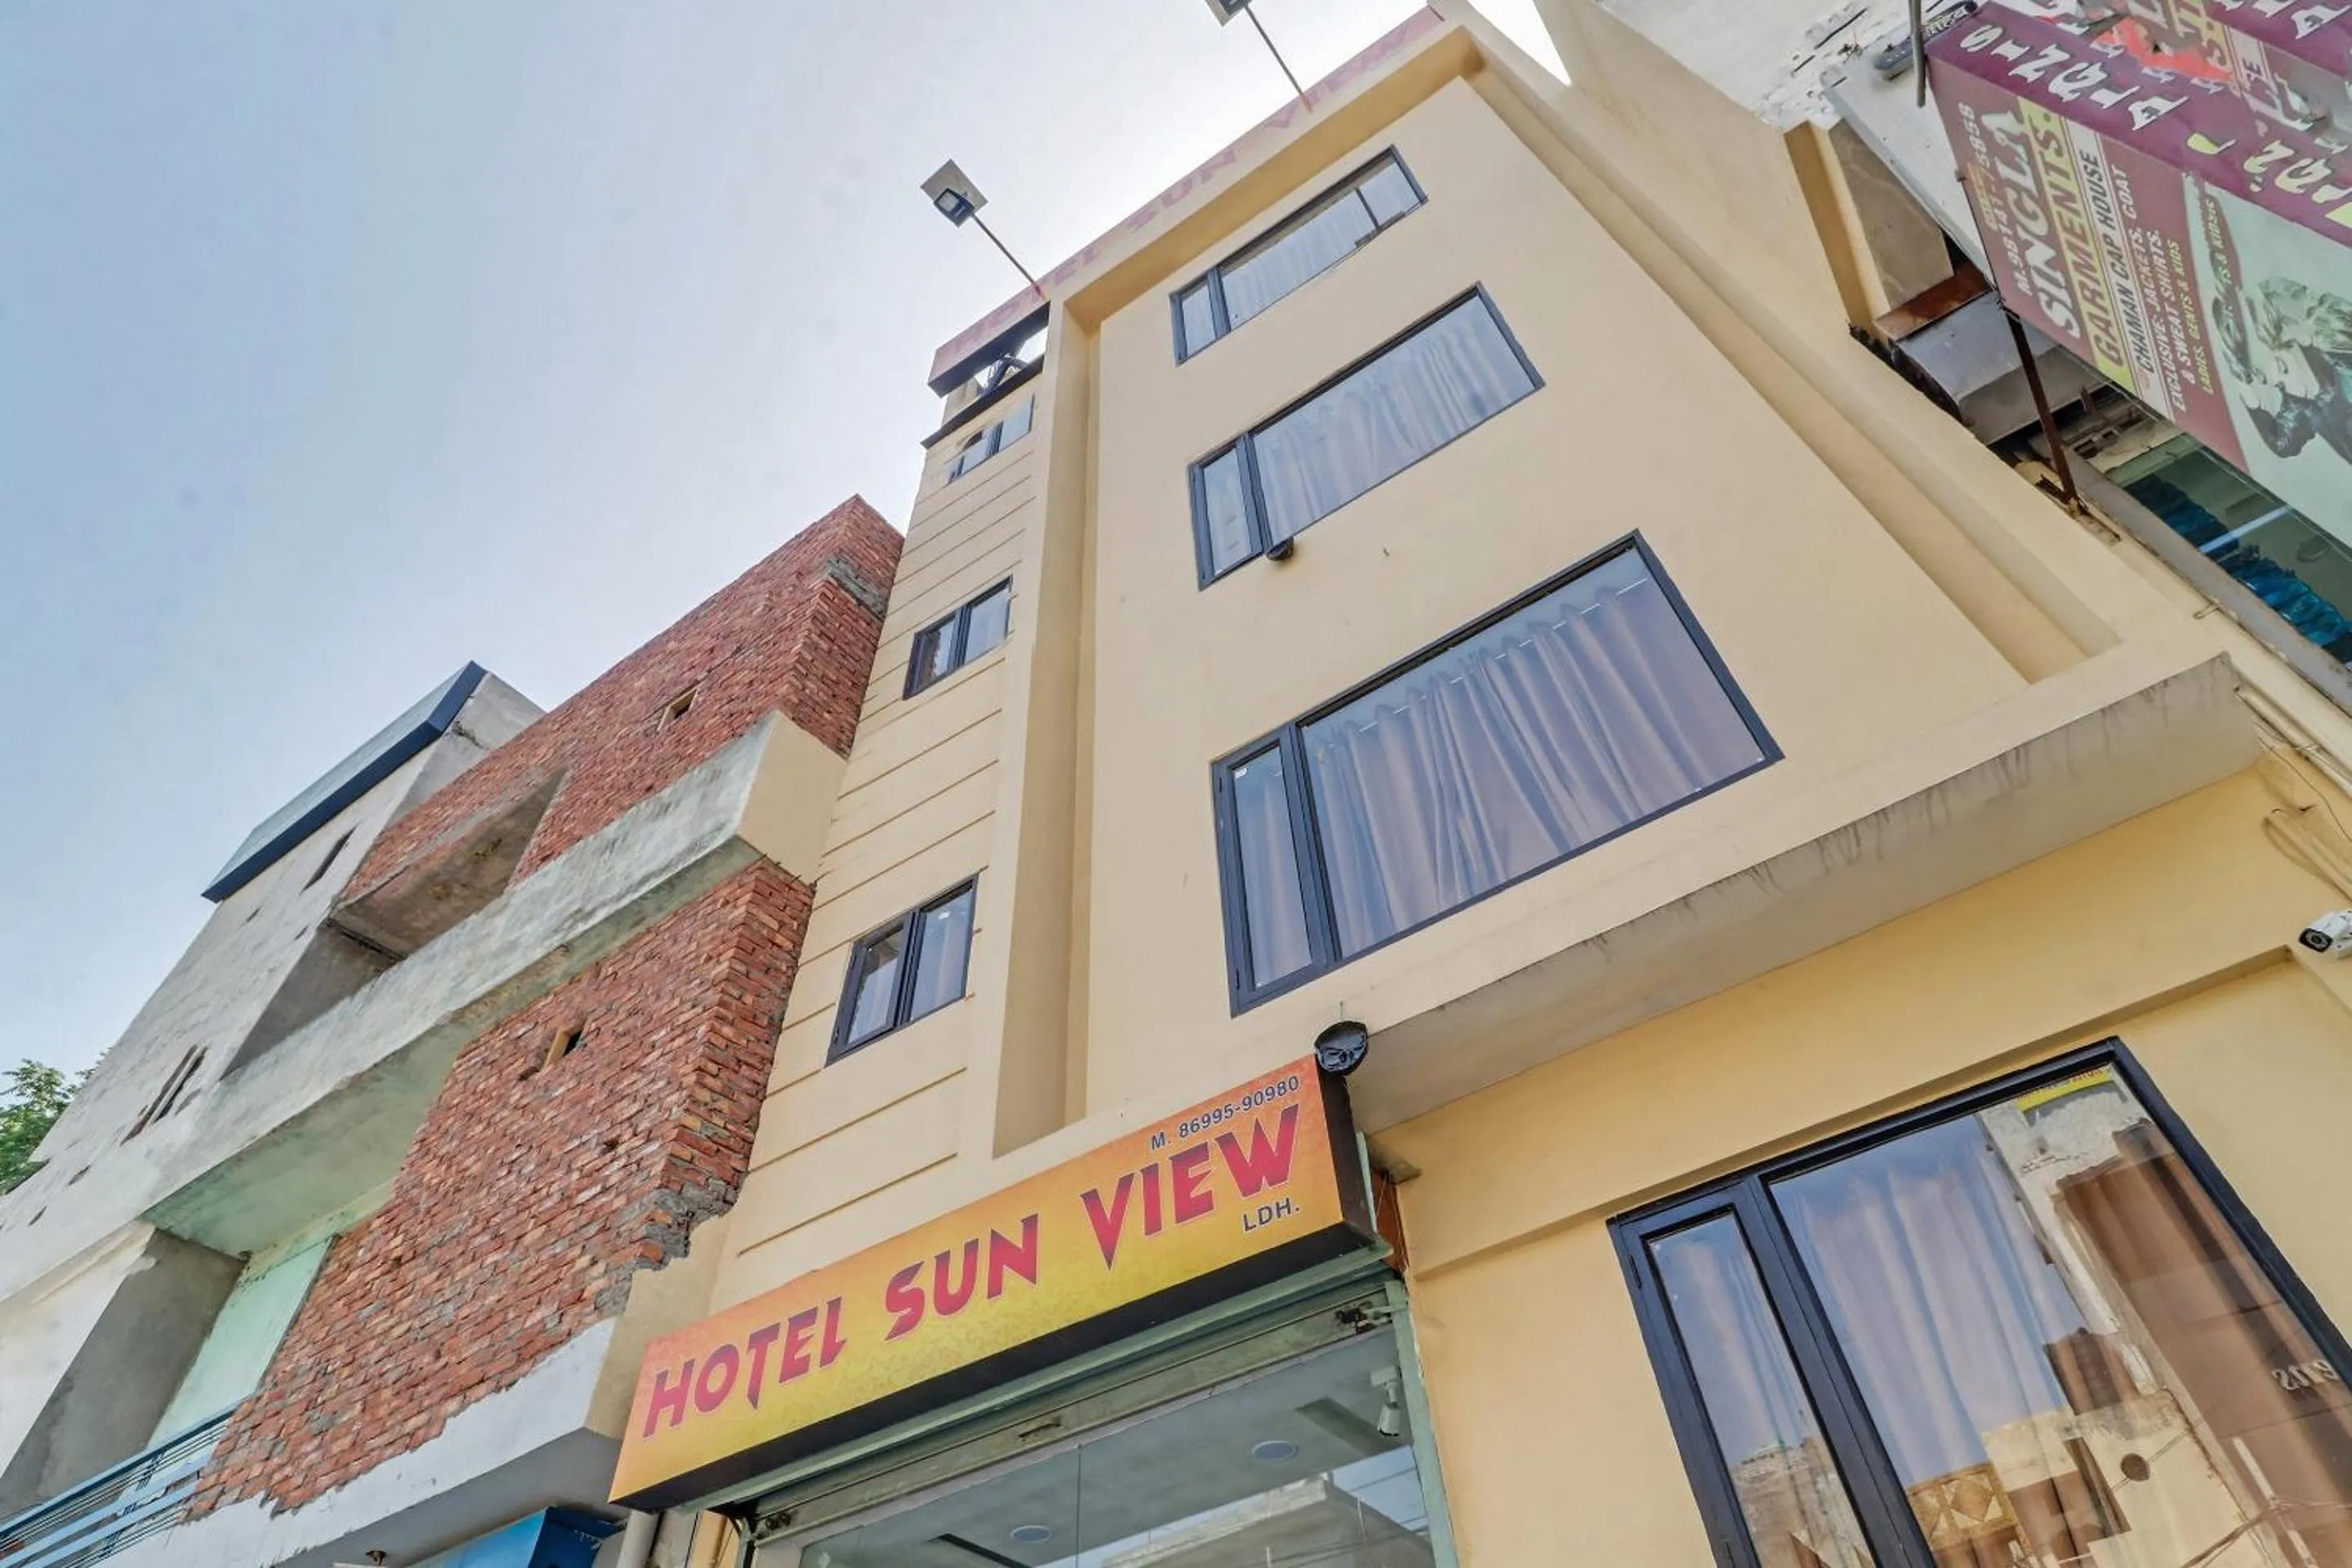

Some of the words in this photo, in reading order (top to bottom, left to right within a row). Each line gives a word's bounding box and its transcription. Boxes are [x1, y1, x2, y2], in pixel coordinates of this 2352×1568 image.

[2080, 150, 2113, 233] HOUSE
[2110, 163, 2138, 220] COAT
[1981, 110, 2082, 340] SINGLA
[2101, 233, 2130, 279] CAP
[2167, 238, 2185, 276] KIDS
[2112, 284, 2156, 375] CHAMAN
[2165, 302, 2192, 366] SWEAT
[2181, 292, 2201, 340] GENTS
[1178, 1074, 1302, 1140] 86995-90980
[1241, 1197, 1303, 1233] LDH.
[641, 1298, 847, 1441] HOTEL
[884, 1214, 1040, 1343] SUN
[1080, 1103, 1302, 1271] VIEW
